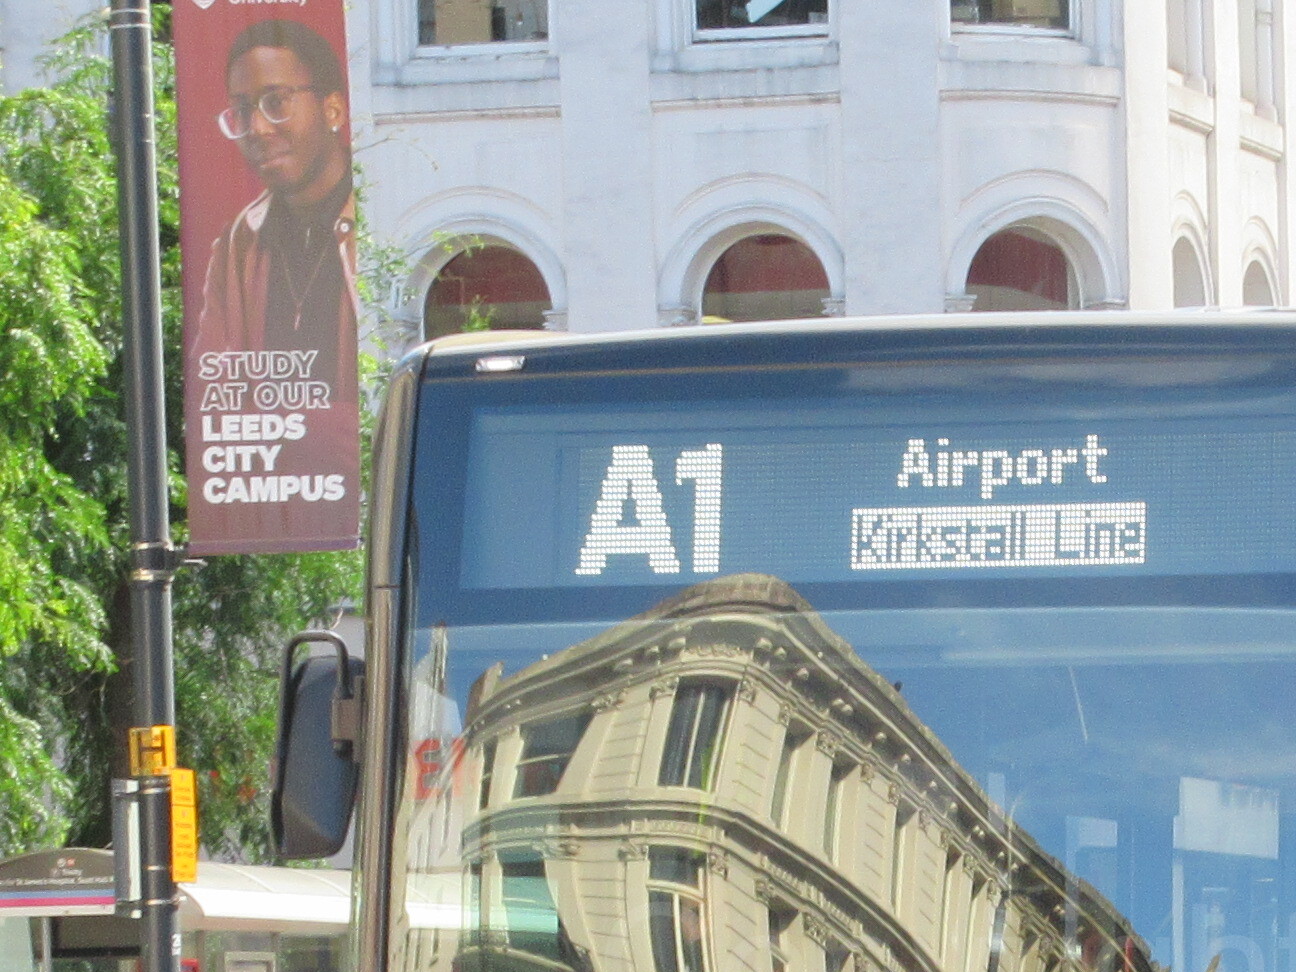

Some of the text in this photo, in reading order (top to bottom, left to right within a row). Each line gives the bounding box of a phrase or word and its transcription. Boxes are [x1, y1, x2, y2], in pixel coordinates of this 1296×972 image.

[198, 350, 318, 380] STUDY
[200, 381, 331, 411] AT OUR
[202, 413, 306, 442] LEEDS
[202, 444, 282, 473] CITY
[203, 474, 345, 504] CAMPUS
[574, 434, 1108, 576] A1 Airport
[857, 509, 1140, 563] Kirkstall Line
